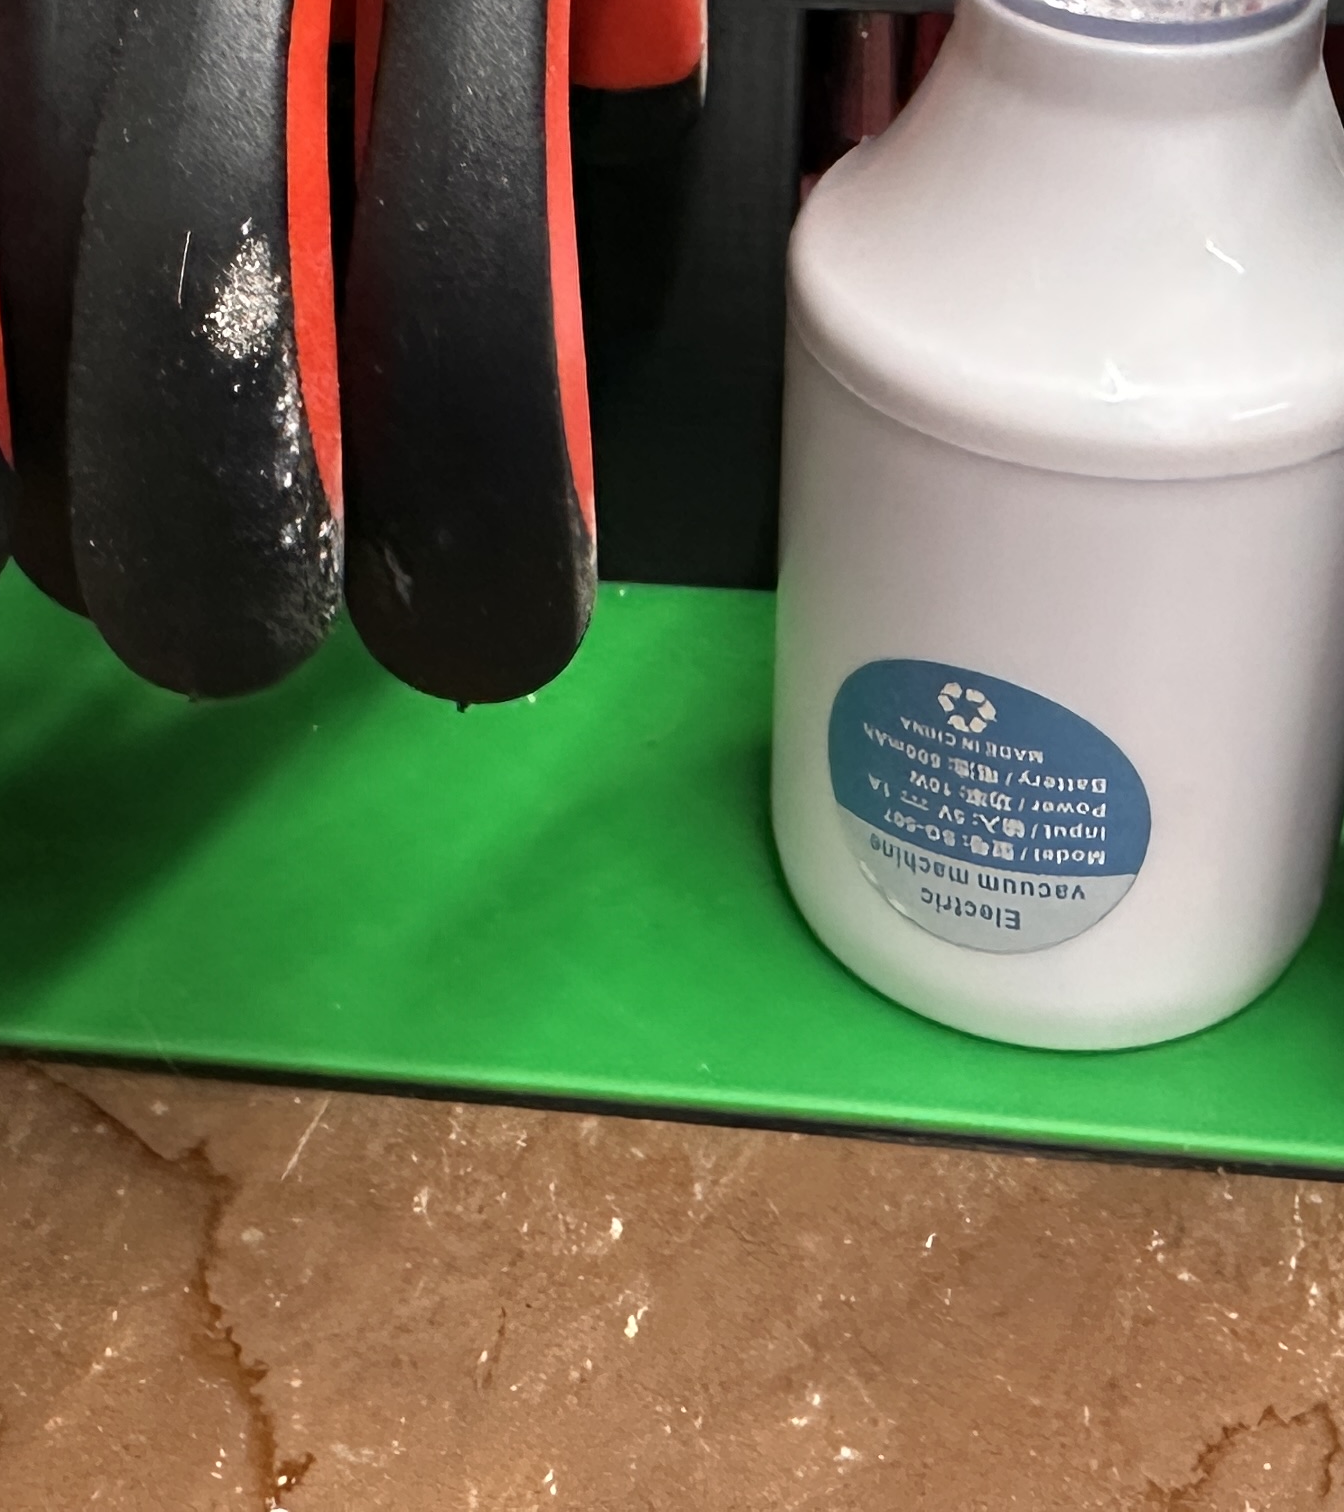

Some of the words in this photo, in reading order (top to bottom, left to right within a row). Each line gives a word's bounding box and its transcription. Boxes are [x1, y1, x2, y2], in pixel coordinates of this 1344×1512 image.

[900, 716, 956, 745] CHINA
[962, 739, 980, 753] IN
[986, 741, 1044, 763] MADE
[1018, 770, 1106, 793] Battery
[1031, 801, 1106, 817] Power
[1044, 824, 1105, 841] Input
[870, 833, 968, 885] machine
[979, 873, 1085, 900] vacuum
